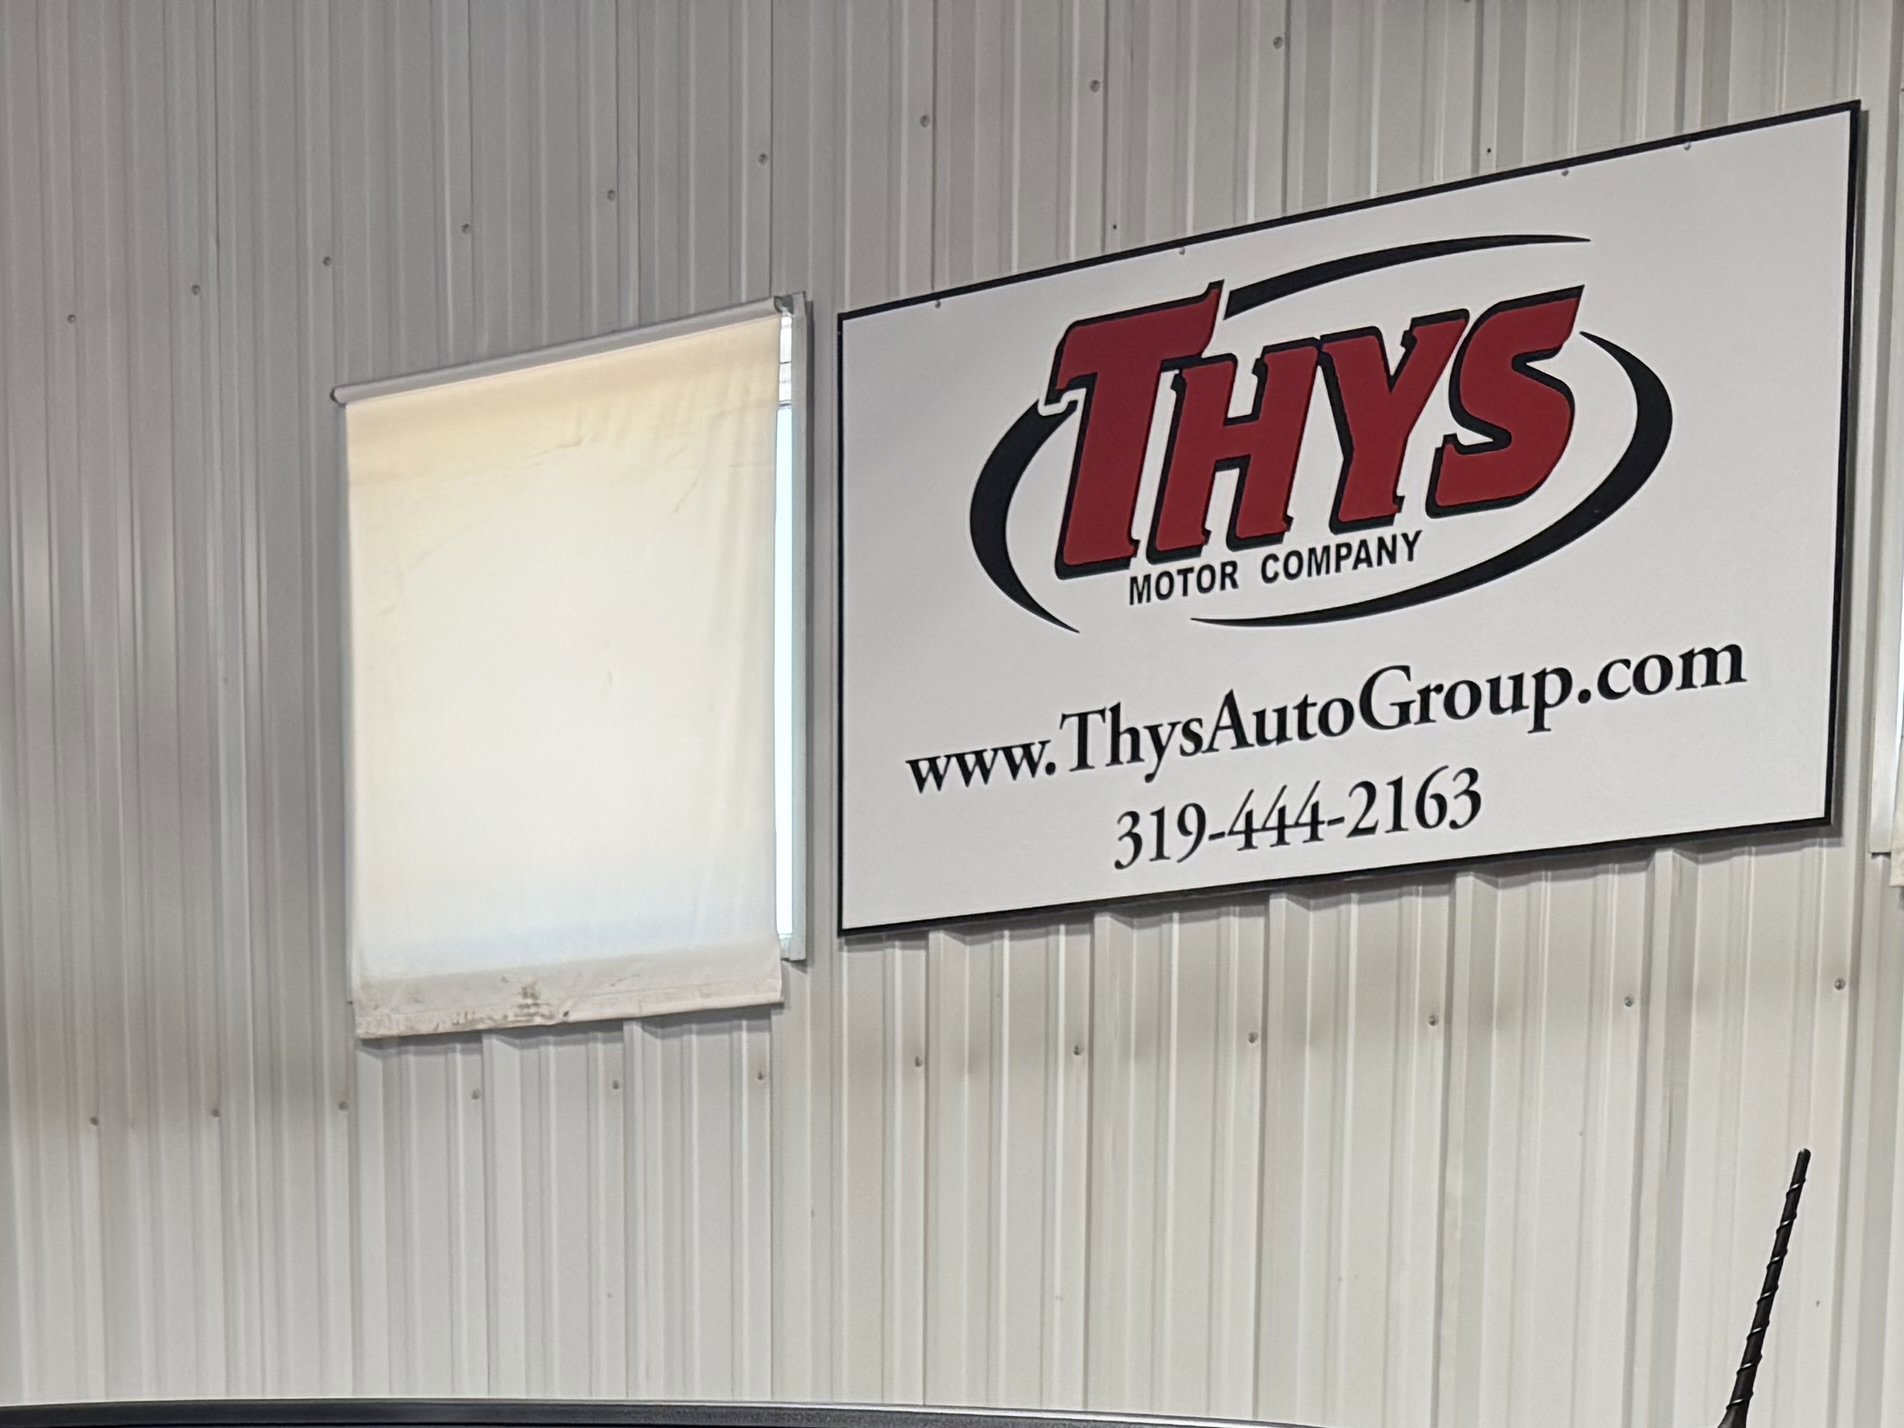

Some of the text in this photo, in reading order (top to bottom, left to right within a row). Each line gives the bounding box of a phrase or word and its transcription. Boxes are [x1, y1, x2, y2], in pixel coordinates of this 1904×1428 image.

[1044, 280, 1584, 578] THYS
[1129, 530, 1421, 605] MOTOR COMPANY
[906, 641, 1746, 793] www.ThysAutoGroup.com
[1114, 766, 1483, 870] 319-444-2163
